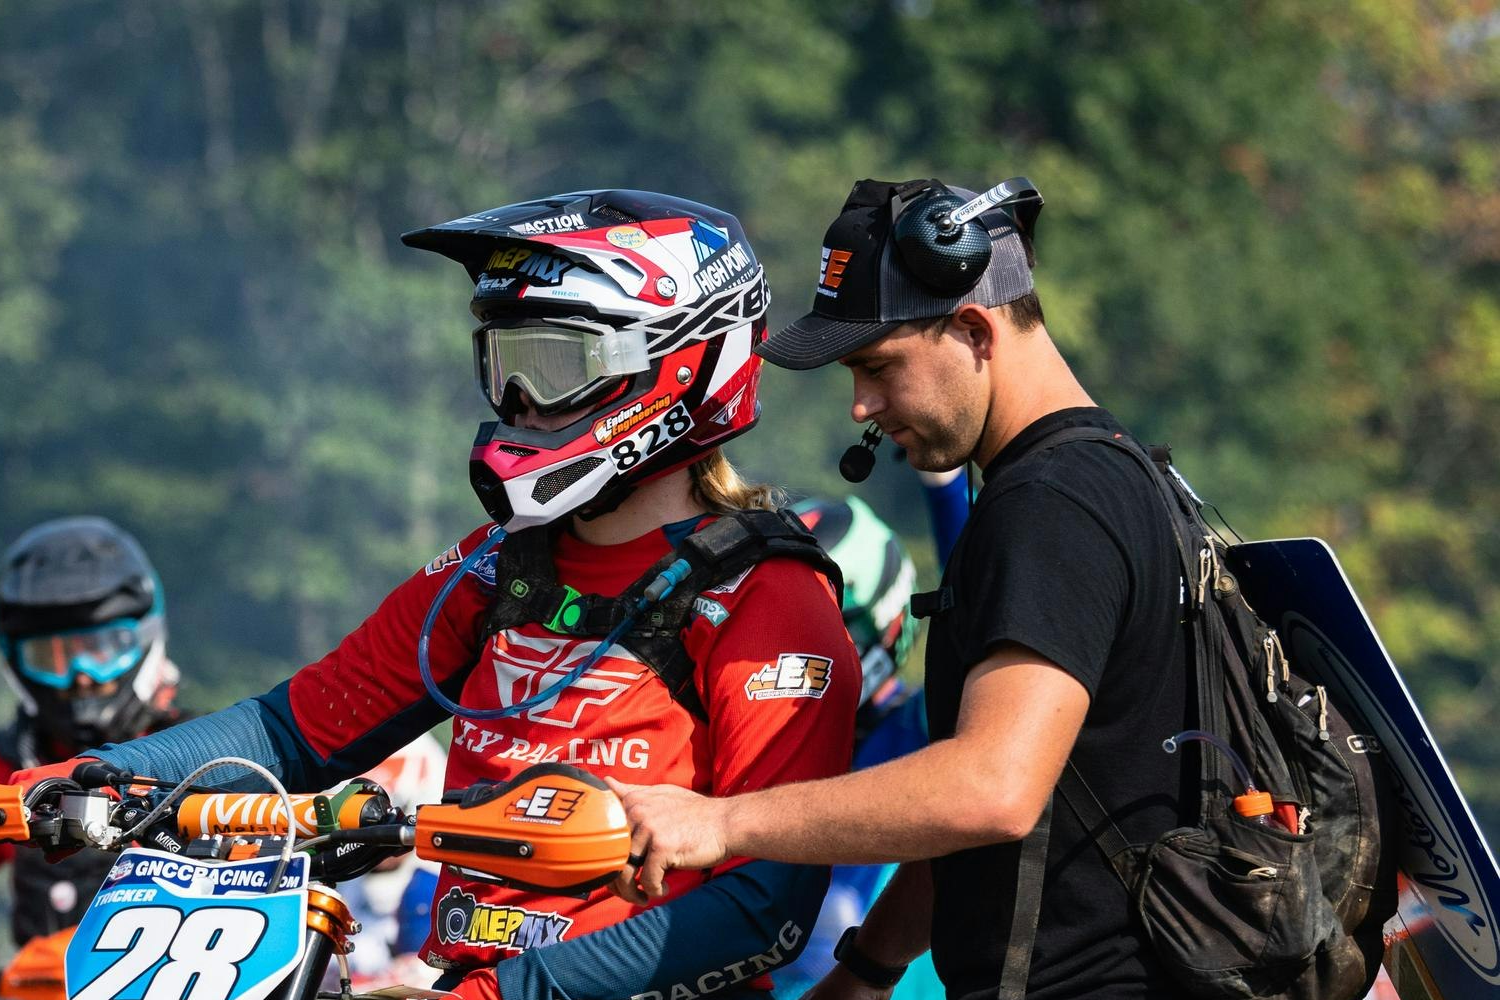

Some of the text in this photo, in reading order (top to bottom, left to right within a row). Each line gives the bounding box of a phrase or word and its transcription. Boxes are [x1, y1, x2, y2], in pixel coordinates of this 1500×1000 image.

[523, 212, 585, 232] ACTION
[695, 258, 727, 297] HIGH
[721, 242, 751, 278] POINT
[605, 402, 643, 431] Enduro
[611, 394, 672, 437] Engineering
[611, 404, 692, 471] 828
[524, 786, 585, 821] EE
[212, 823, 290, 836] Metals
[135, 859, 301, 889] GNCCRACING.OM
[96, 888, 158, 908] TRICKER
[465, 906, 571, 950] MEPMX
